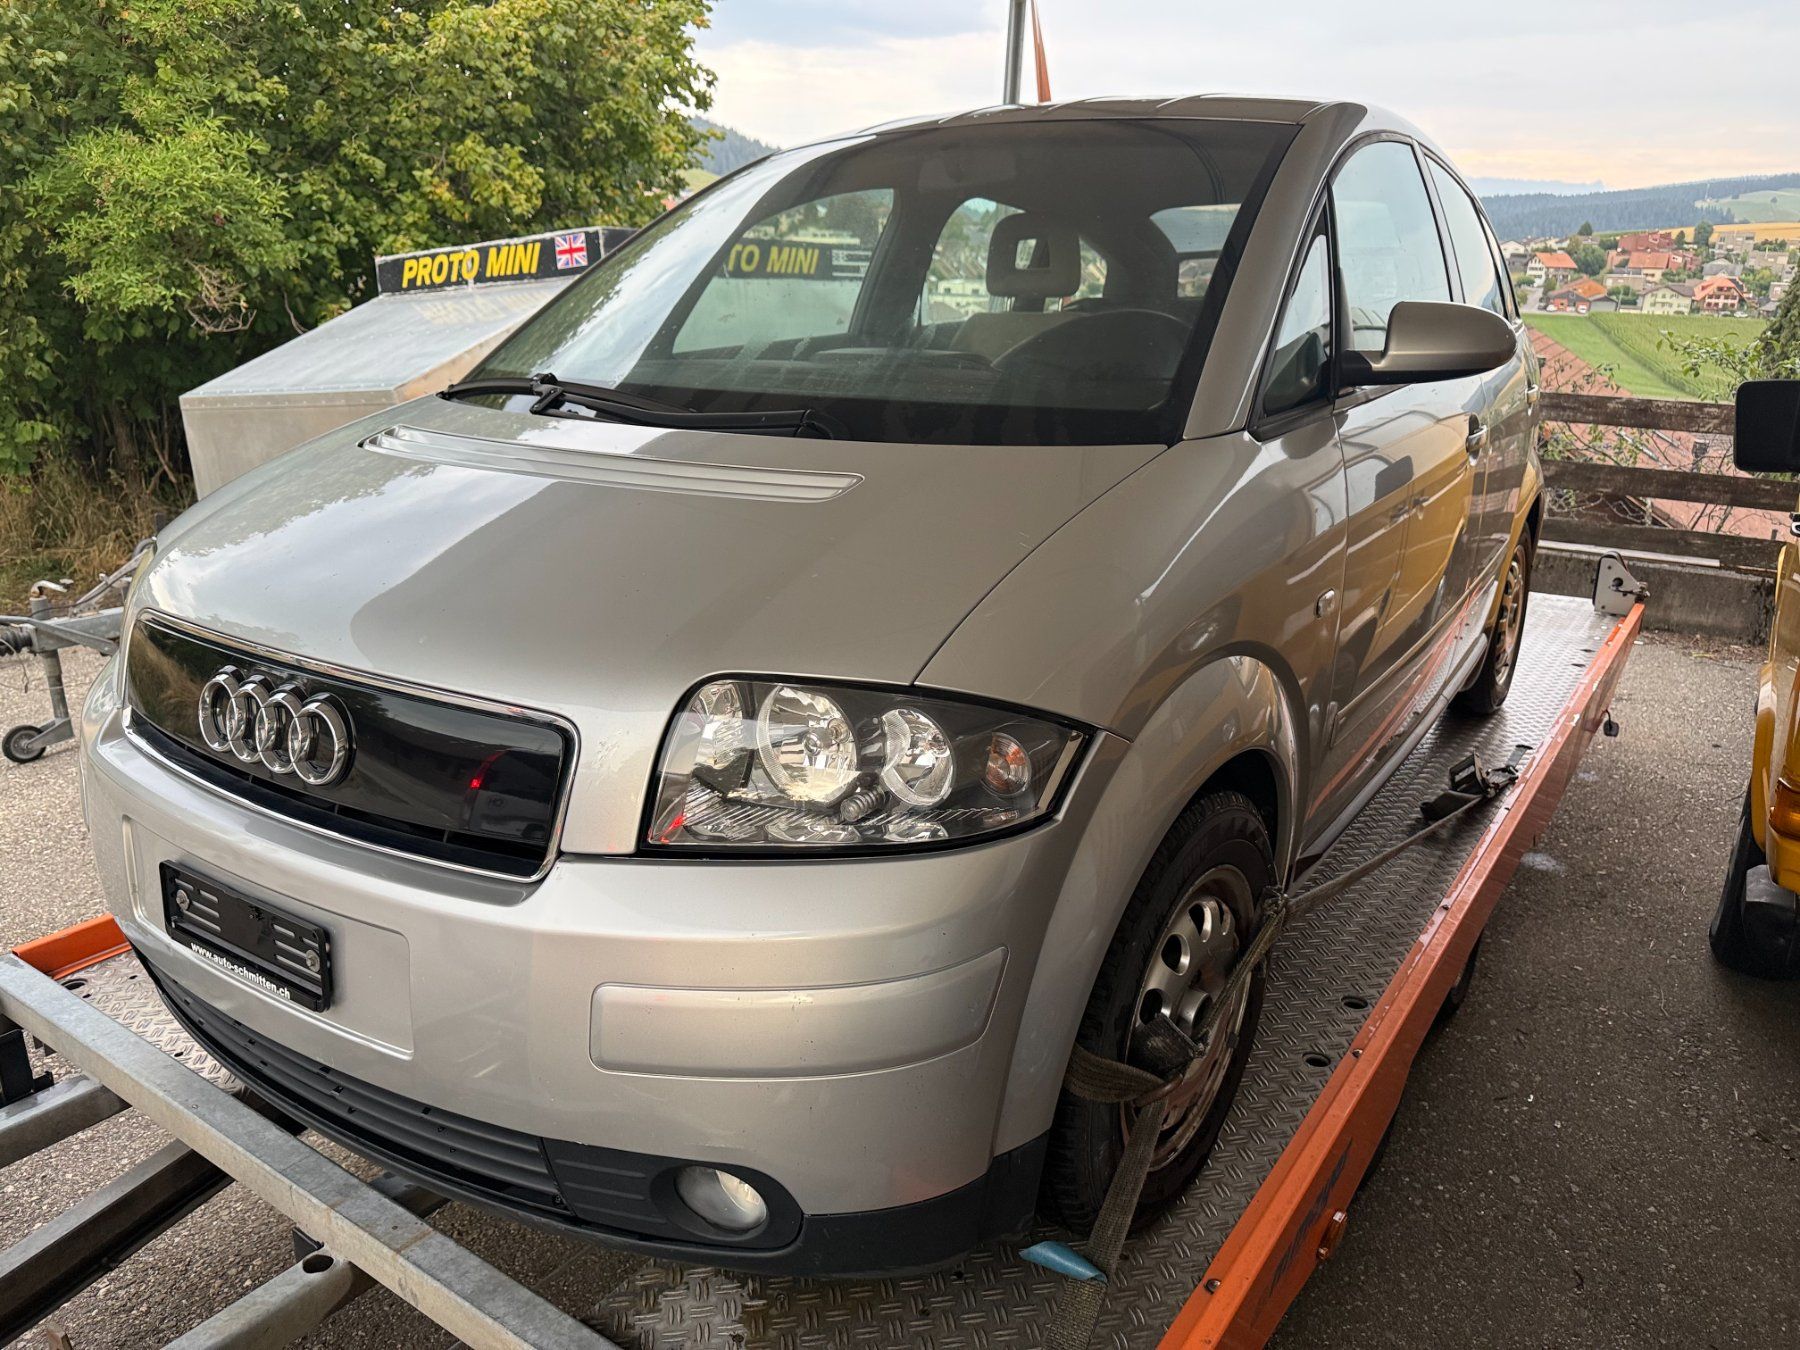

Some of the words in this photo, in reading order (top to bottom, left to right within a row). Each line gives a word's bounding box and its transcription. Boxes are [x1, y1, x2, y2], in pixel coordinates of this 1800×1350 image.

[402, 249, 479, 288] PROTO
[485, 242, 541, 278] MINI
[766, 246, 820, 275] MINI
[190, 942, 291, 1000] www.auto-schmitten.ch
